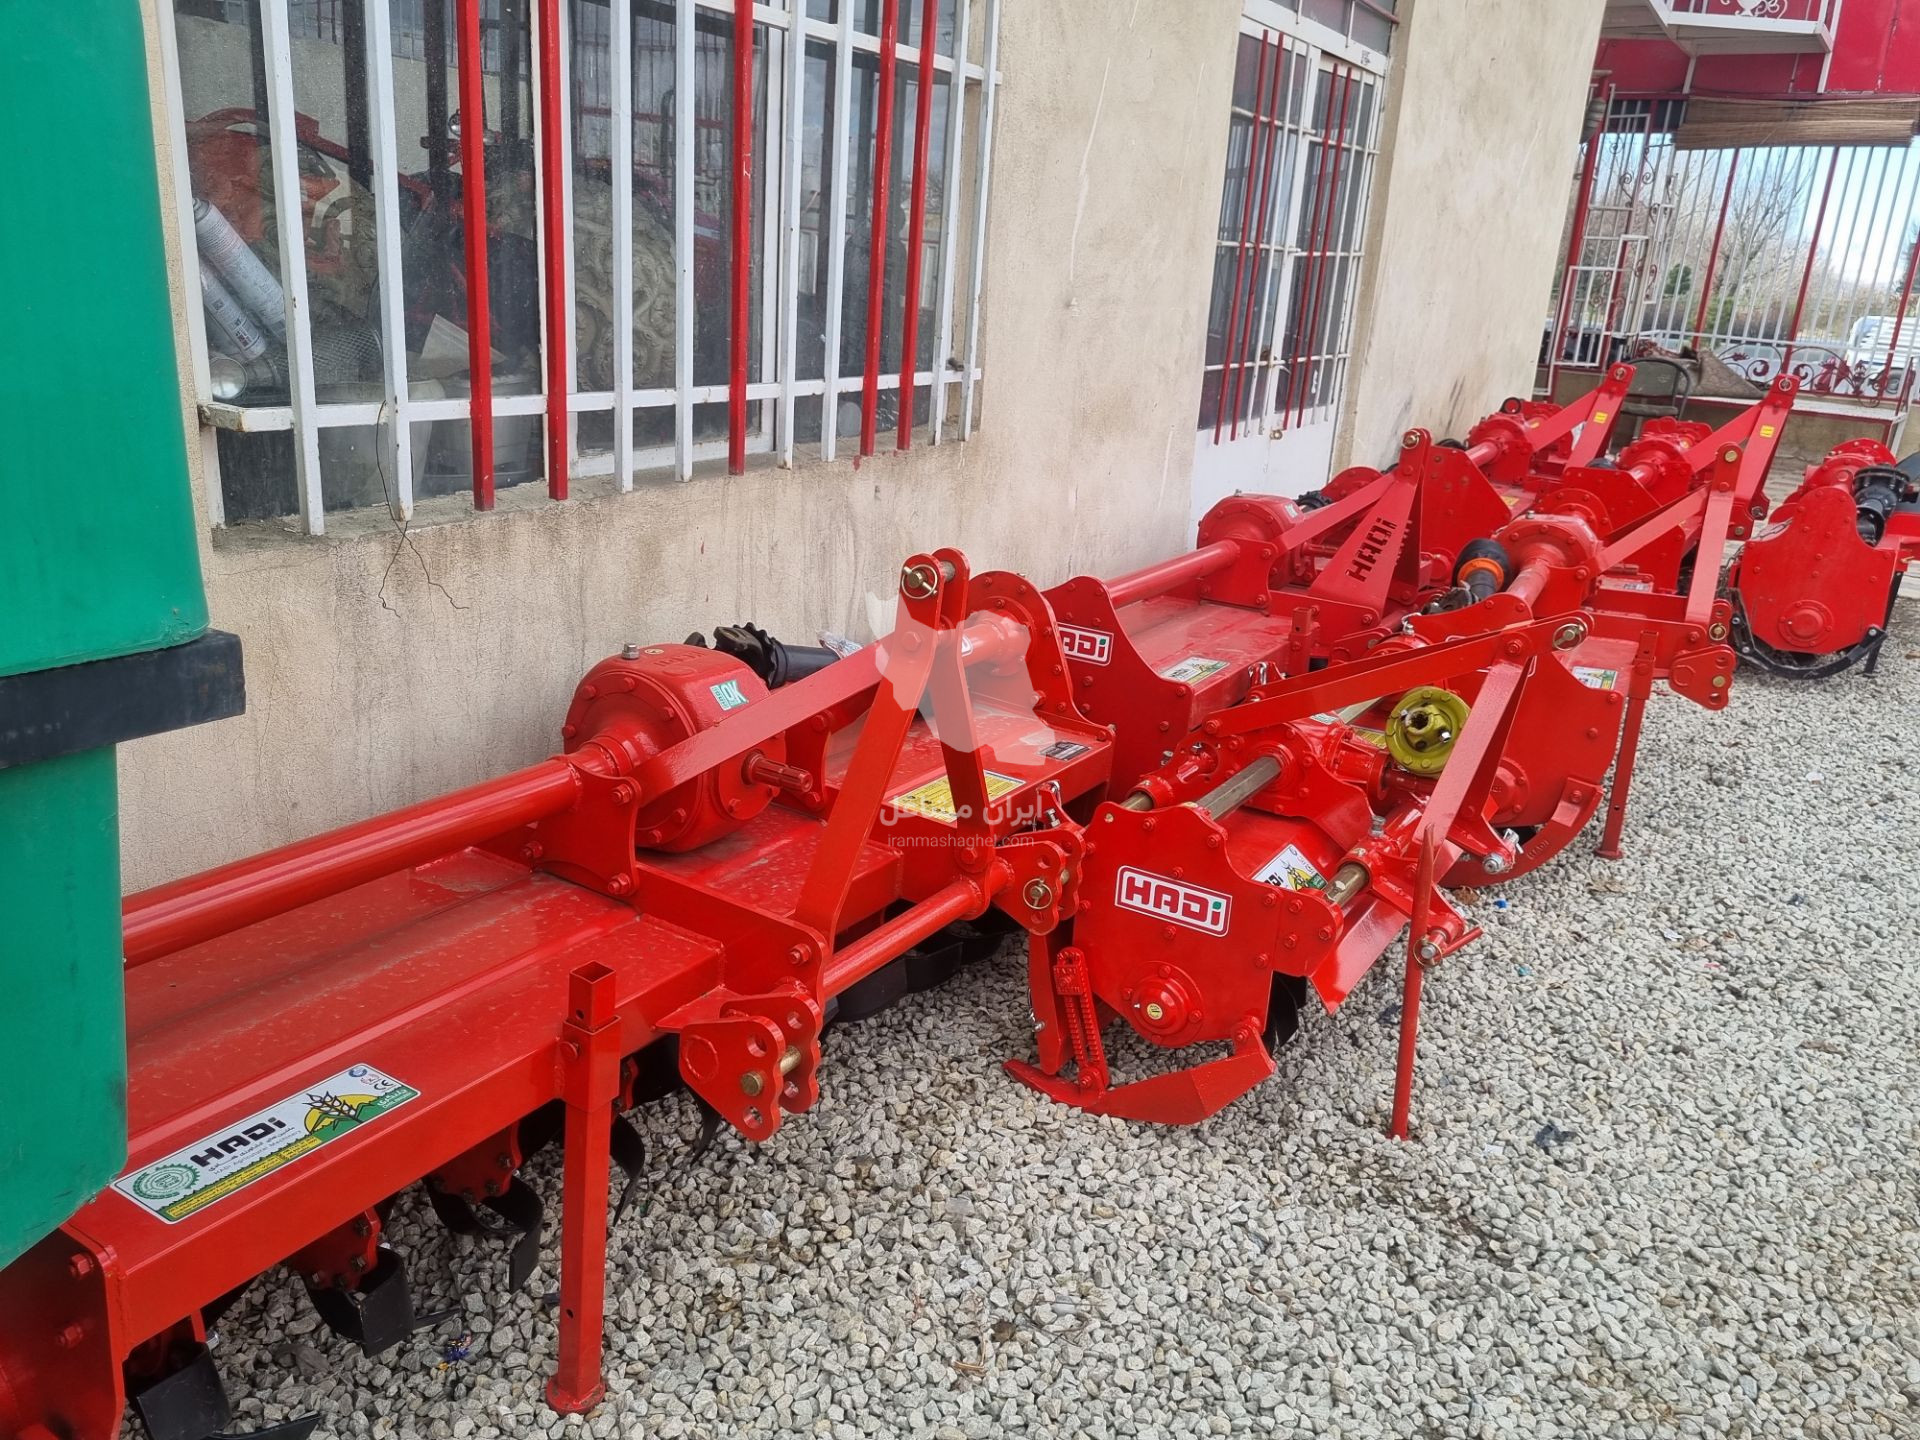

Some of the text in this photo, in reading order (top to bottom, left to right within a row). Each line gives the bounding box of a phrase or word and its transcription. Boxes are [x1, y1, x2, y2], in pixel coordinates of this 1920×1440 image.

[1060, 630, 1106, 658] ADi
[1125, 876, 1221, 926] HADi
[190, 1116, 287, 1167] HADi
